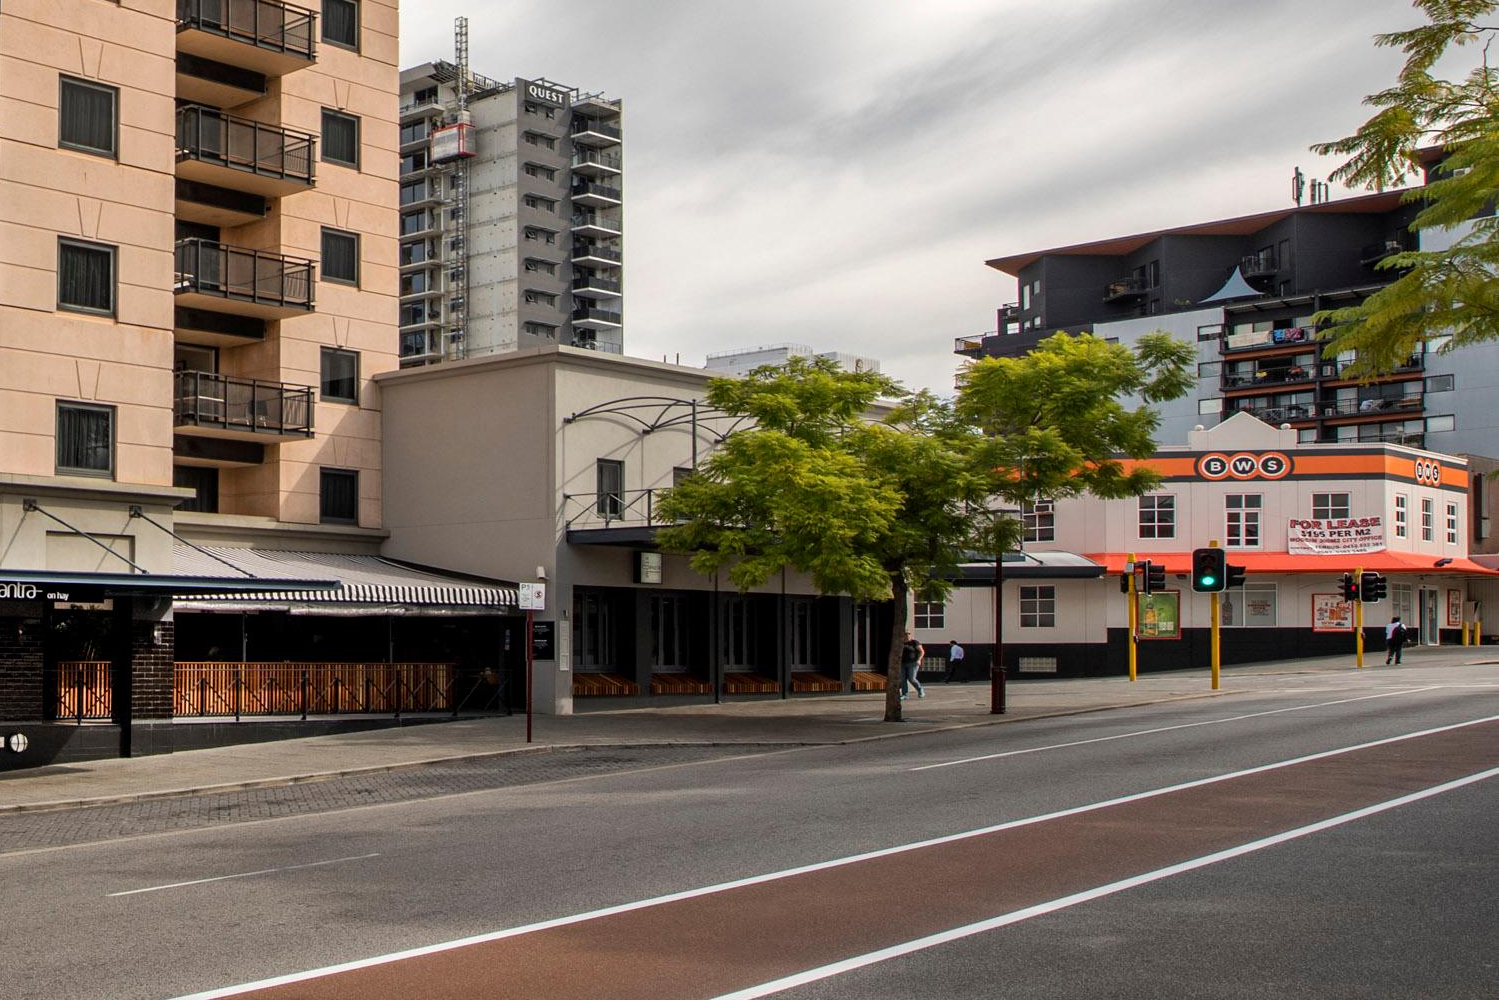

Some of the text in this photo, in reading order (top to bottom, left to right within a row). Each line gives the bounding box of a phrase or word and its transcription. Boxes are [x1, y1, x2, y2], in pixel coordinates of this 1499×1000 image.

[529, 85, 564, 104] QUEST
[1289, 517, 1381, 529] FOR LEASE
[1355, 528, 1371, 536] M2
[56, 592, 69, 601] hay
